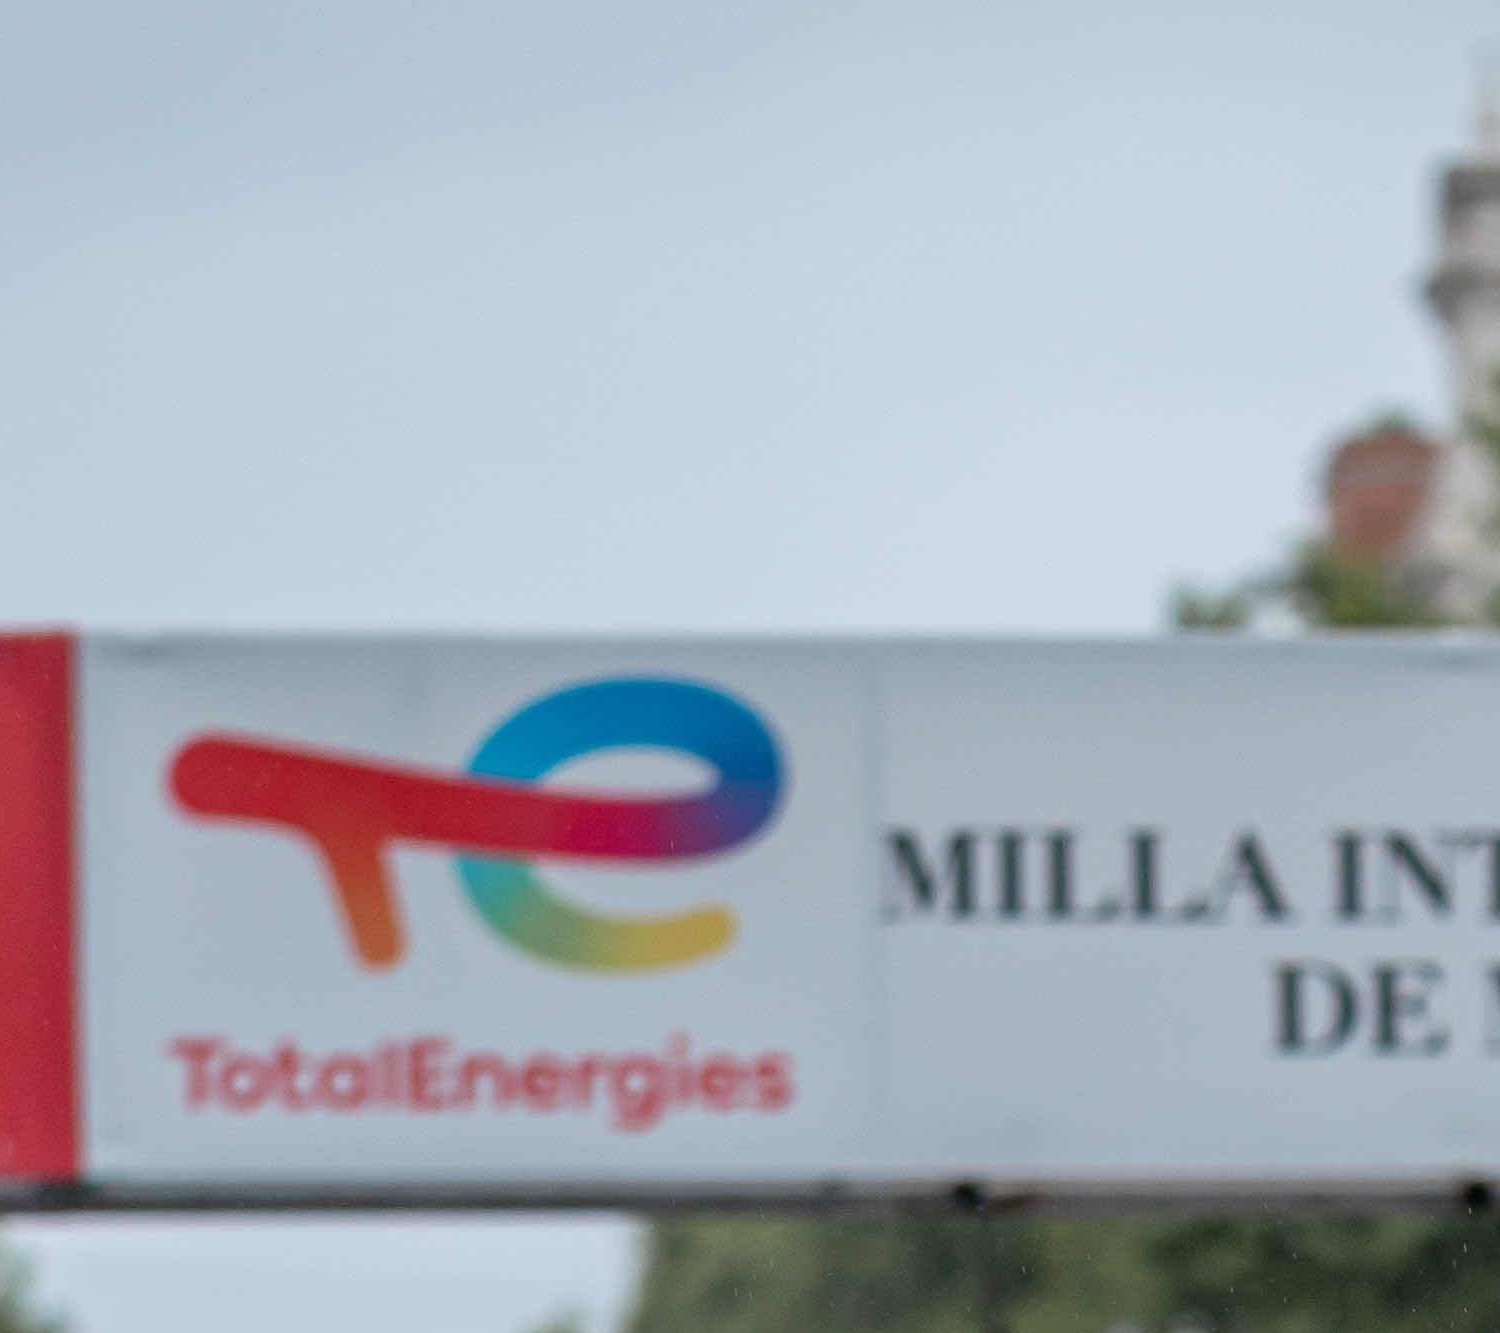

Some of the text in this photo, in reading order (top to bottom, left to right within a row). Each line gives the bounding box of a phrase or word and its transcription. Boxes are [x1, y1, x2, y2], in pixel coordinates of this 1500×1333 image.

[878, 825, 1290, 925] MILLA
[1268, 958, 1447, 1059] DE
[169, 1034, 795, 1133] TotalEnergies
